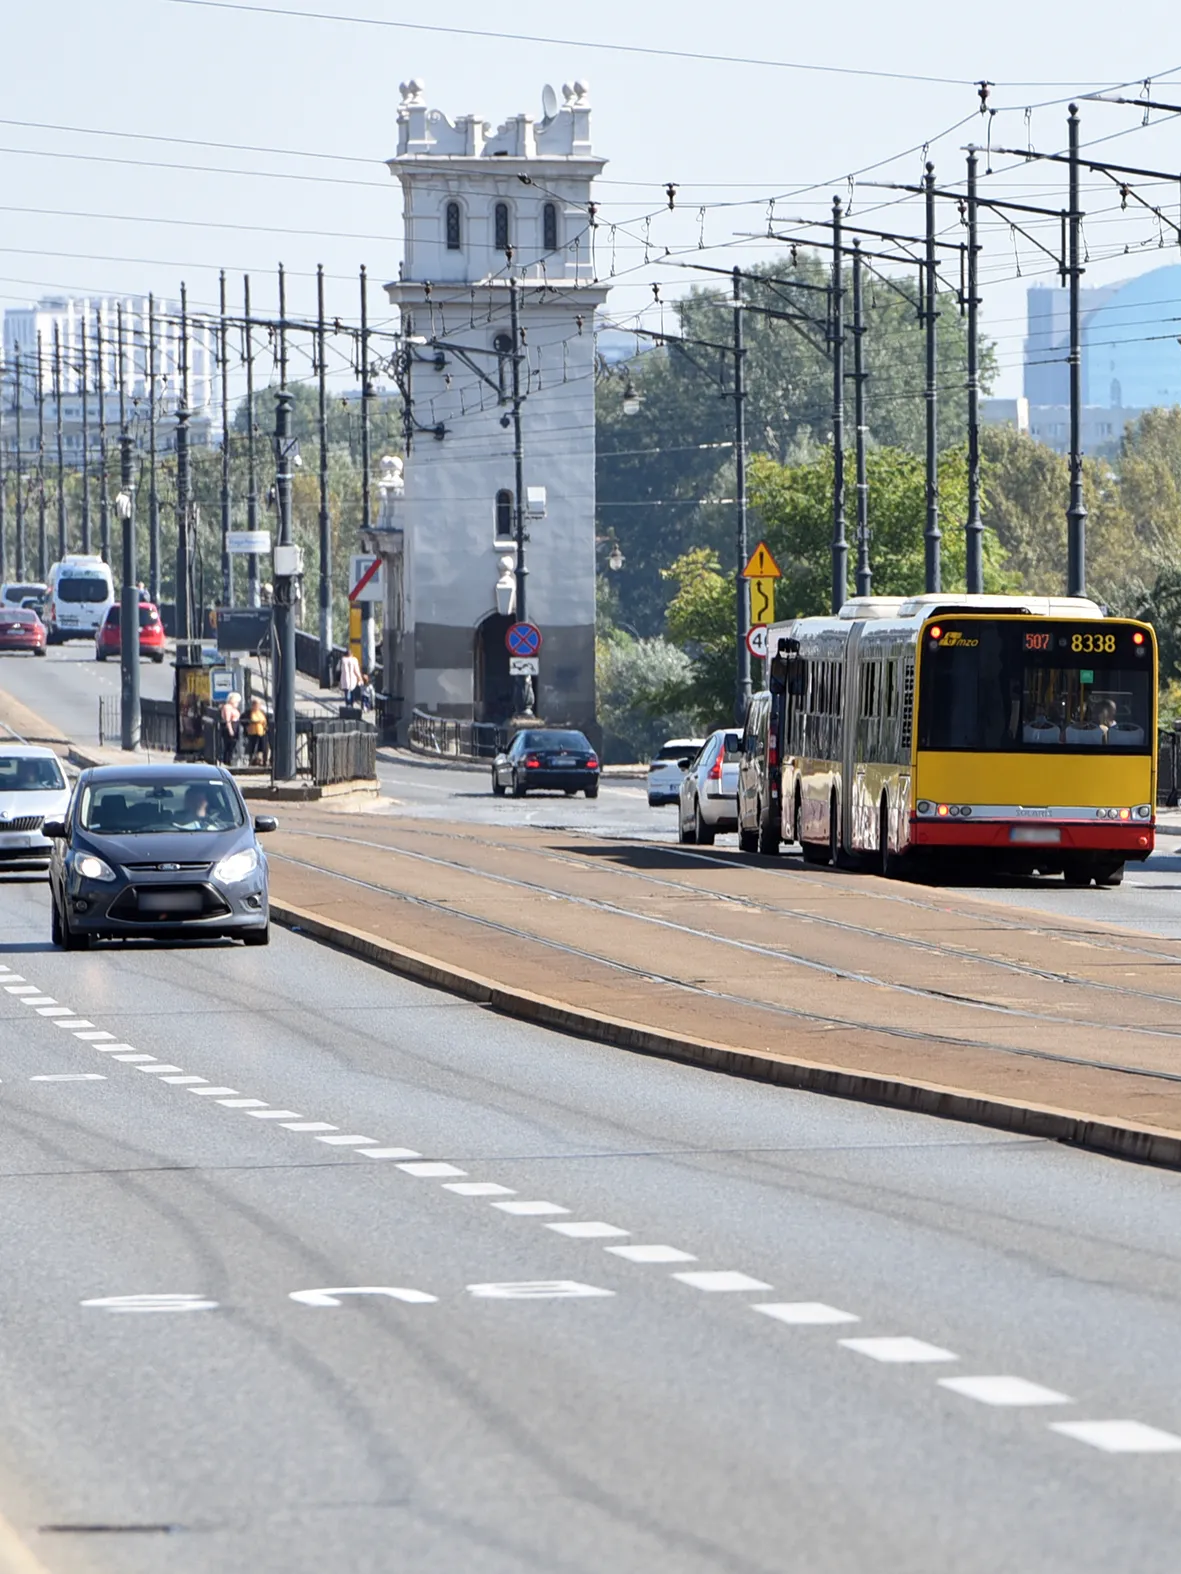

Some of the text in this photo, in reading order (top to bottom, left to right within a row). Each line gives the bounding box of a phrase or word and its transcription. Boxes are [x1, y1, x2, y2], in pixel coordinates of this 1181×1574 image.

[1025, 633, 1050, 649] 507
[1071, 634, 1116, 653] 8338
[1015, 810, 1053, 818] SOLARIS
[81, 1280, 615, 1312] BUS
